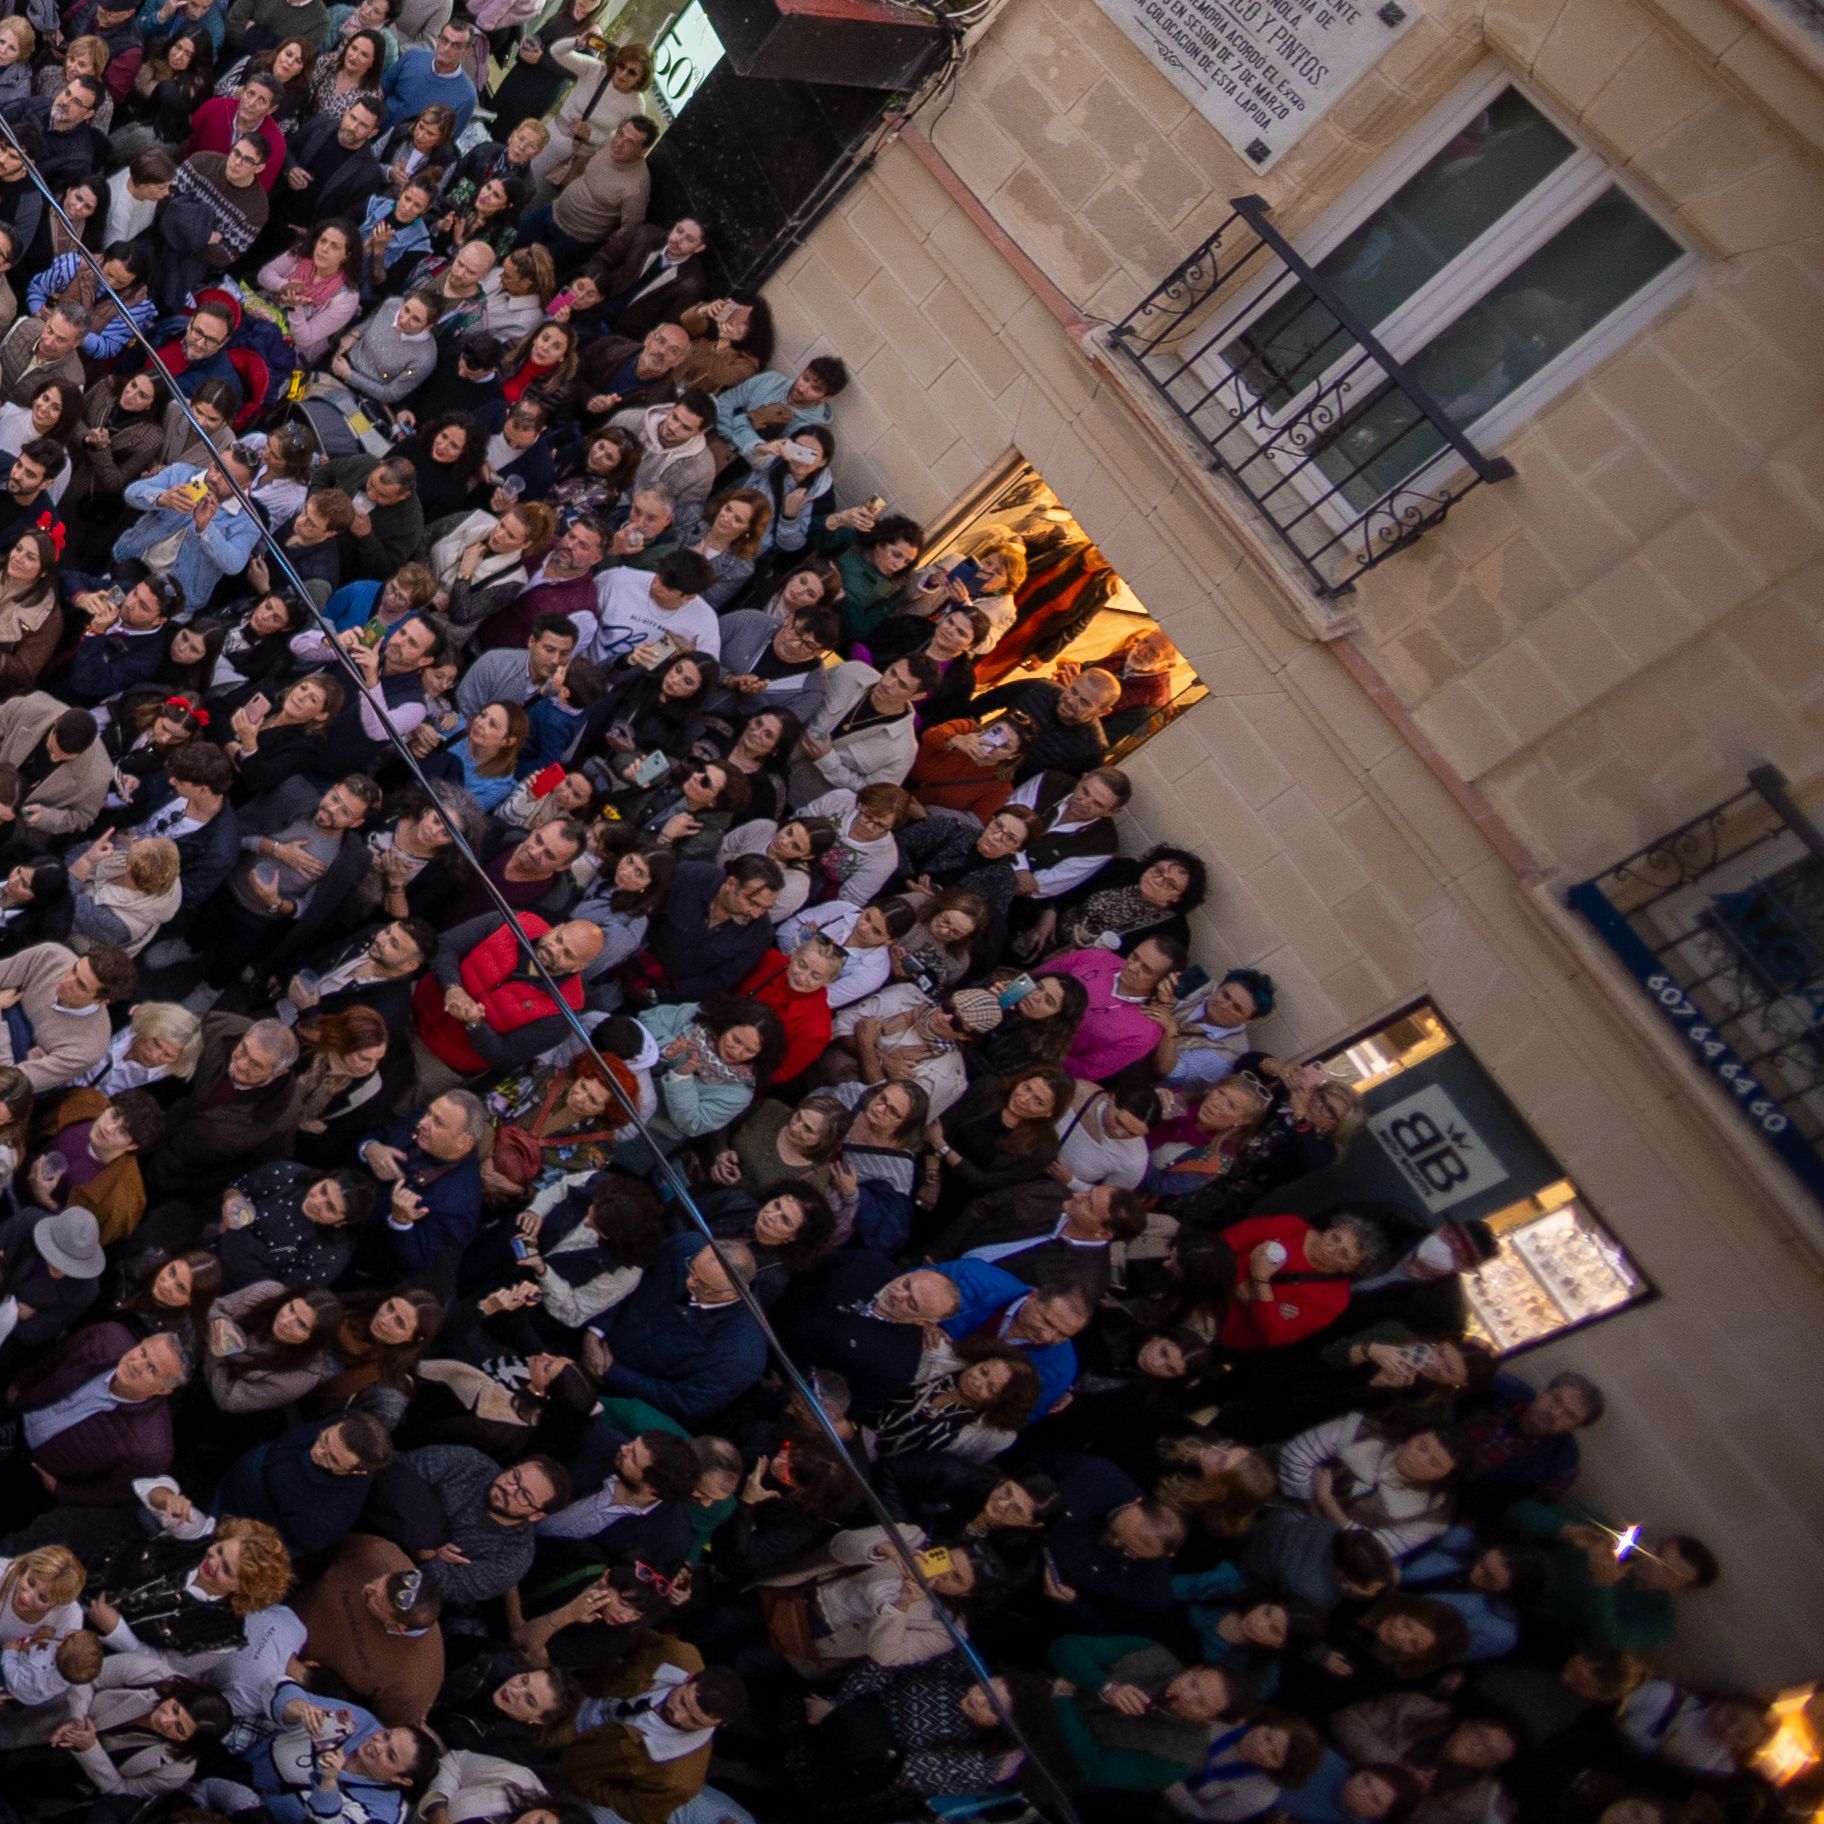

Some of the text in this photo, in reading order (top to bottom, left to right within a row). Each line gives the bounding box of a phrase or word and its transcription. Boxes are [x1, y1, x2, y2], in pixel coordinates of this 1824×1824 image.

[1146, 2, 1202, 61] COLOCACION
[1197, 54, 1216, 73] DE
[1211, 67, 1238, 96] ESTA
[1225, 30, 1268, 69] ACORDÓ
[1262, 65, 1279, 84] EL
[1256, 12, 1276, 33] Y
[1315, 10, 1336, 30] DE
[1171, 0, 1188, 19] EN
[1184, 14, 1221, 52] SESION
[1216, 46, 1235, 65] DE
[1230, 59, 1244, 72] 7
[1238, 69, 1257, 88] DE
[1252, 82, 1290, 120] MARZO
[1647, 975, 1787, 1133] 607 64 64 60
